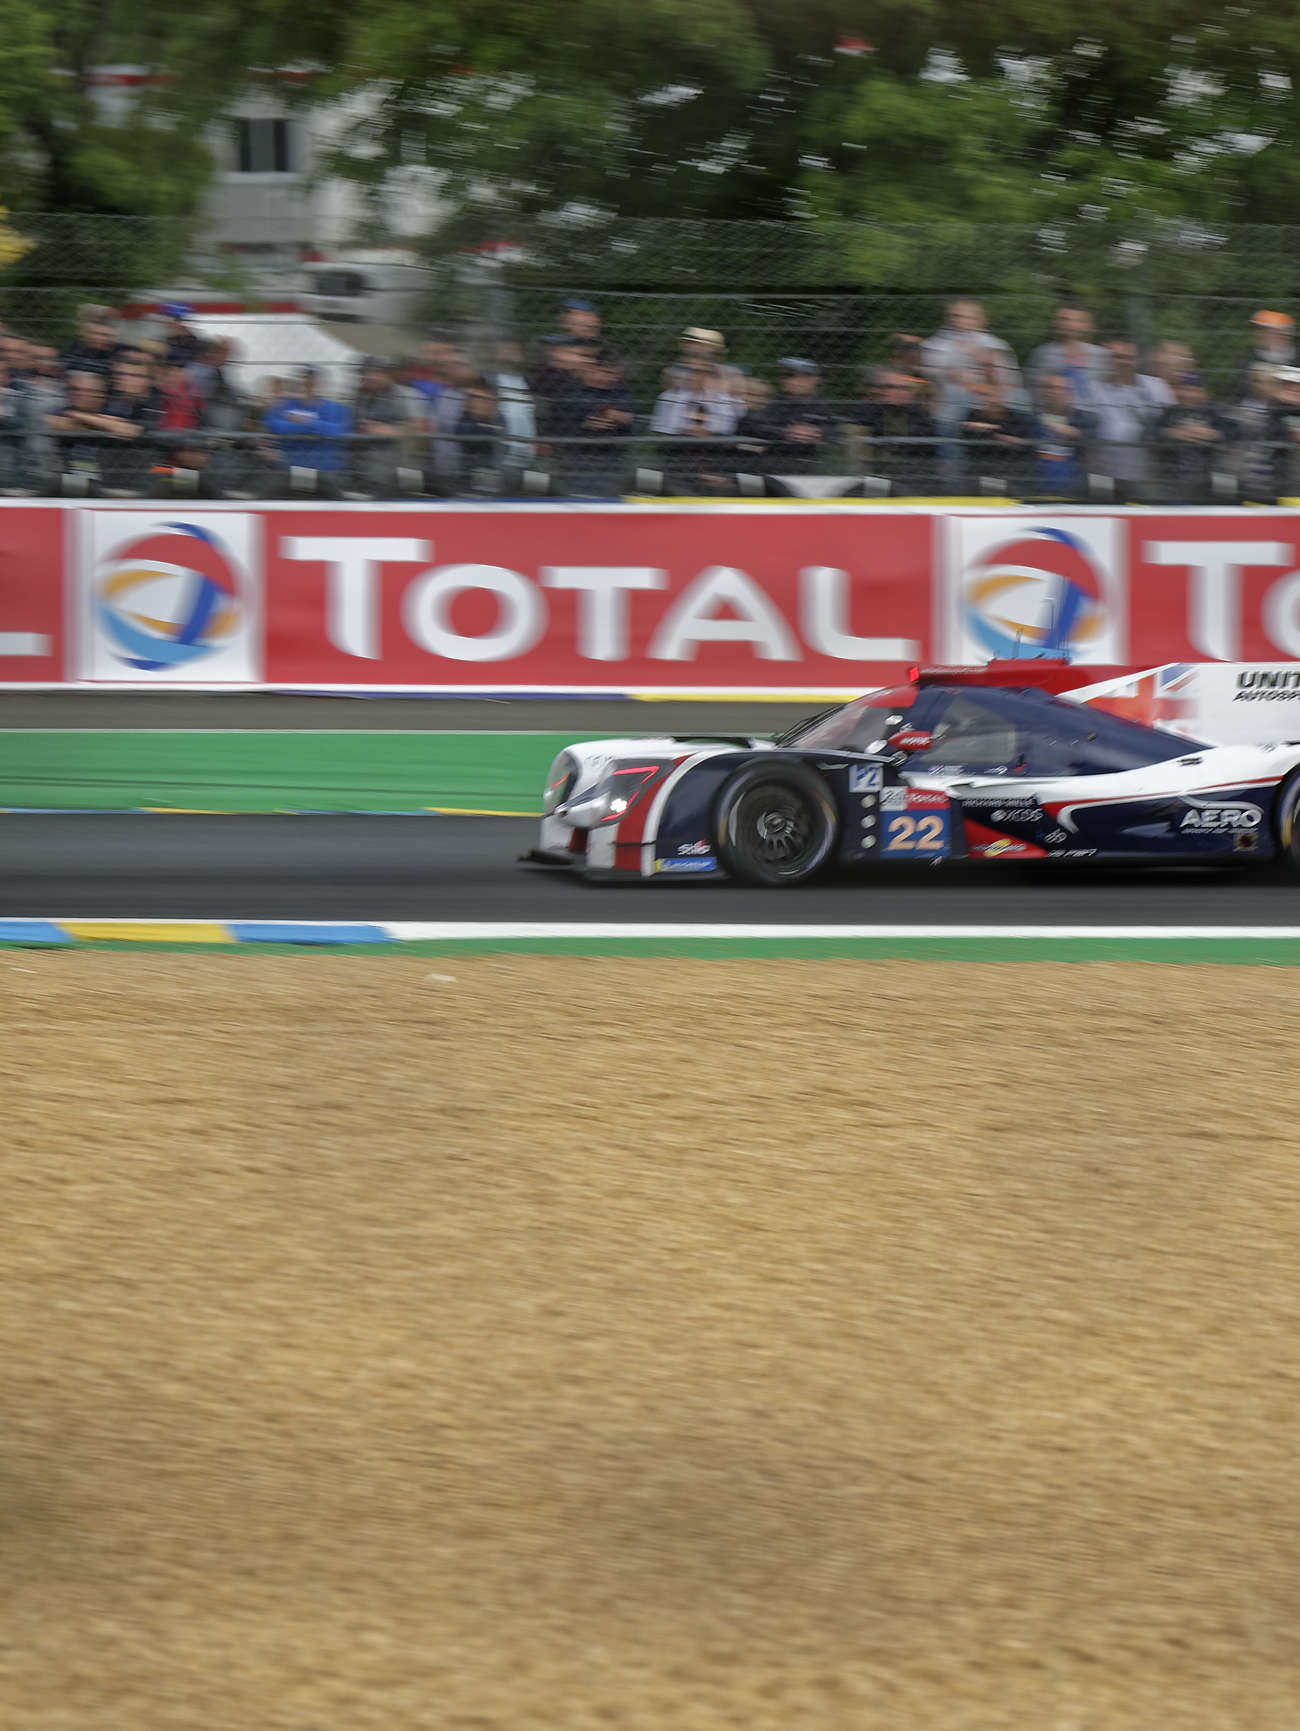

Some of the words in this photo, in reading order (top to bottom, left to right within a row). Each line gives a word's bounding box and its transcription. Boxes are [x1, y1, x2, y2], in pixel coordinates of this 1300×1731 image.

[280, 536, 920, 663] TOTAL
[887, 815, 945, 851] 22
[1179, 808, 1263, 829] AERO
